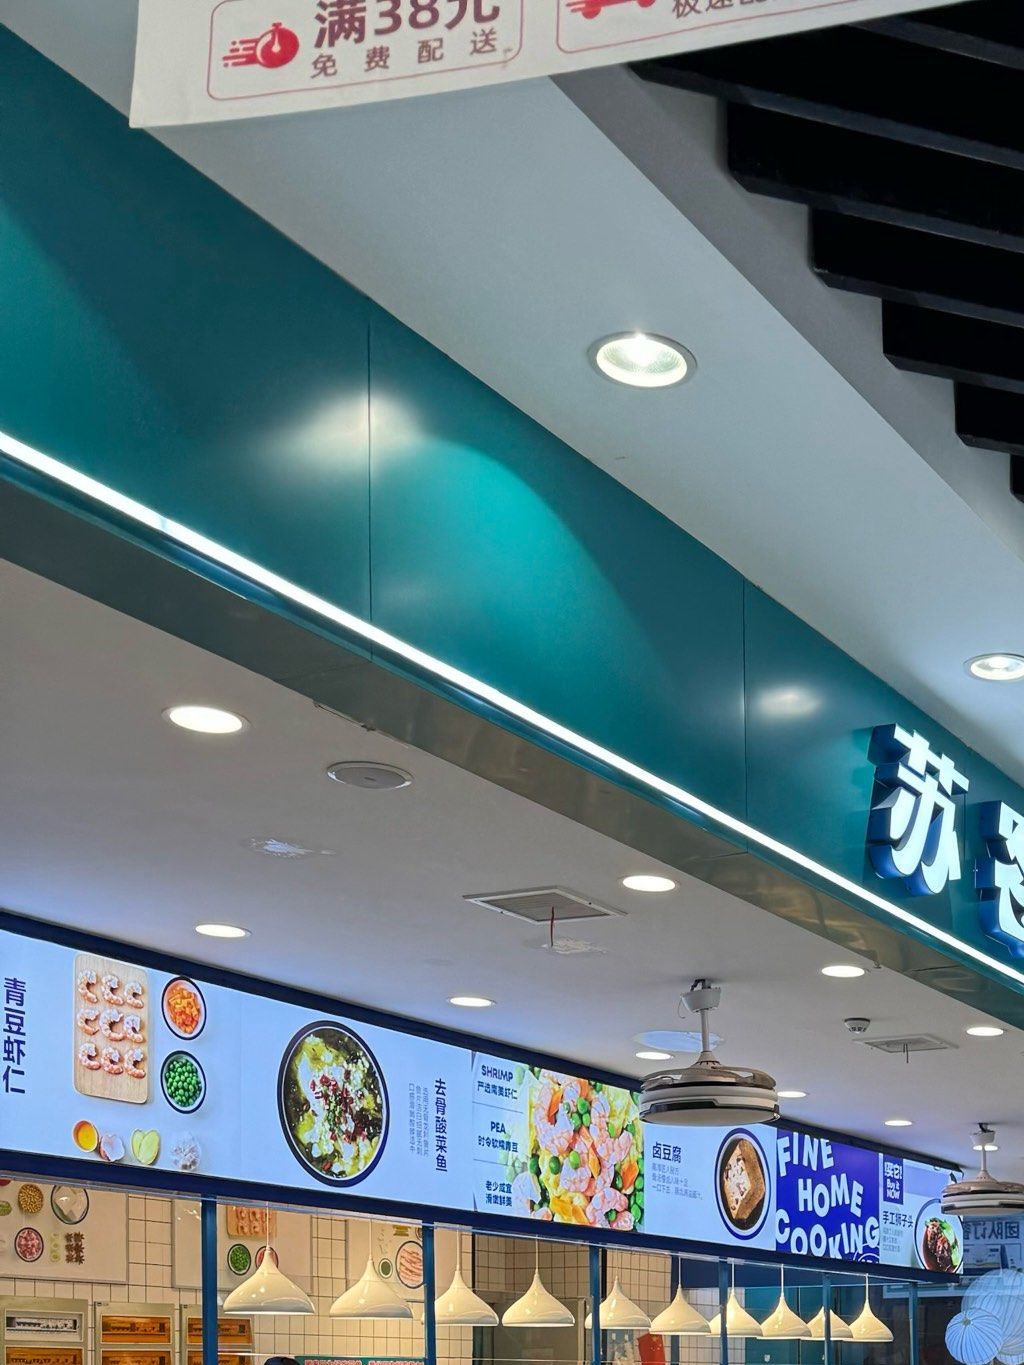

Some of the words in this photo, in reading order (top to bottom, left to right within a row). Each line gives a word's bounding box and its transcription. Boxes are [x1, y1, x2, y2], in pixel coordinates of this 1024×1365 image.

[310, 27, 498, 79] 免费配送
[2, 976, 27, 1095] 青豆虾仁
[481, 1064, 513, 1082] SHRIMP
[434, 1078, 447, 1172] 去骨酸菜鱼
[490, 1121, 506, 1134] PEA
[652, 1141, 682, 1163] 卤豆腐
[777, 1132, 834, 1177] FINE
[798, 1173, 864, 1218] HOME
[776, 1208, 880, 1260] COOKING
